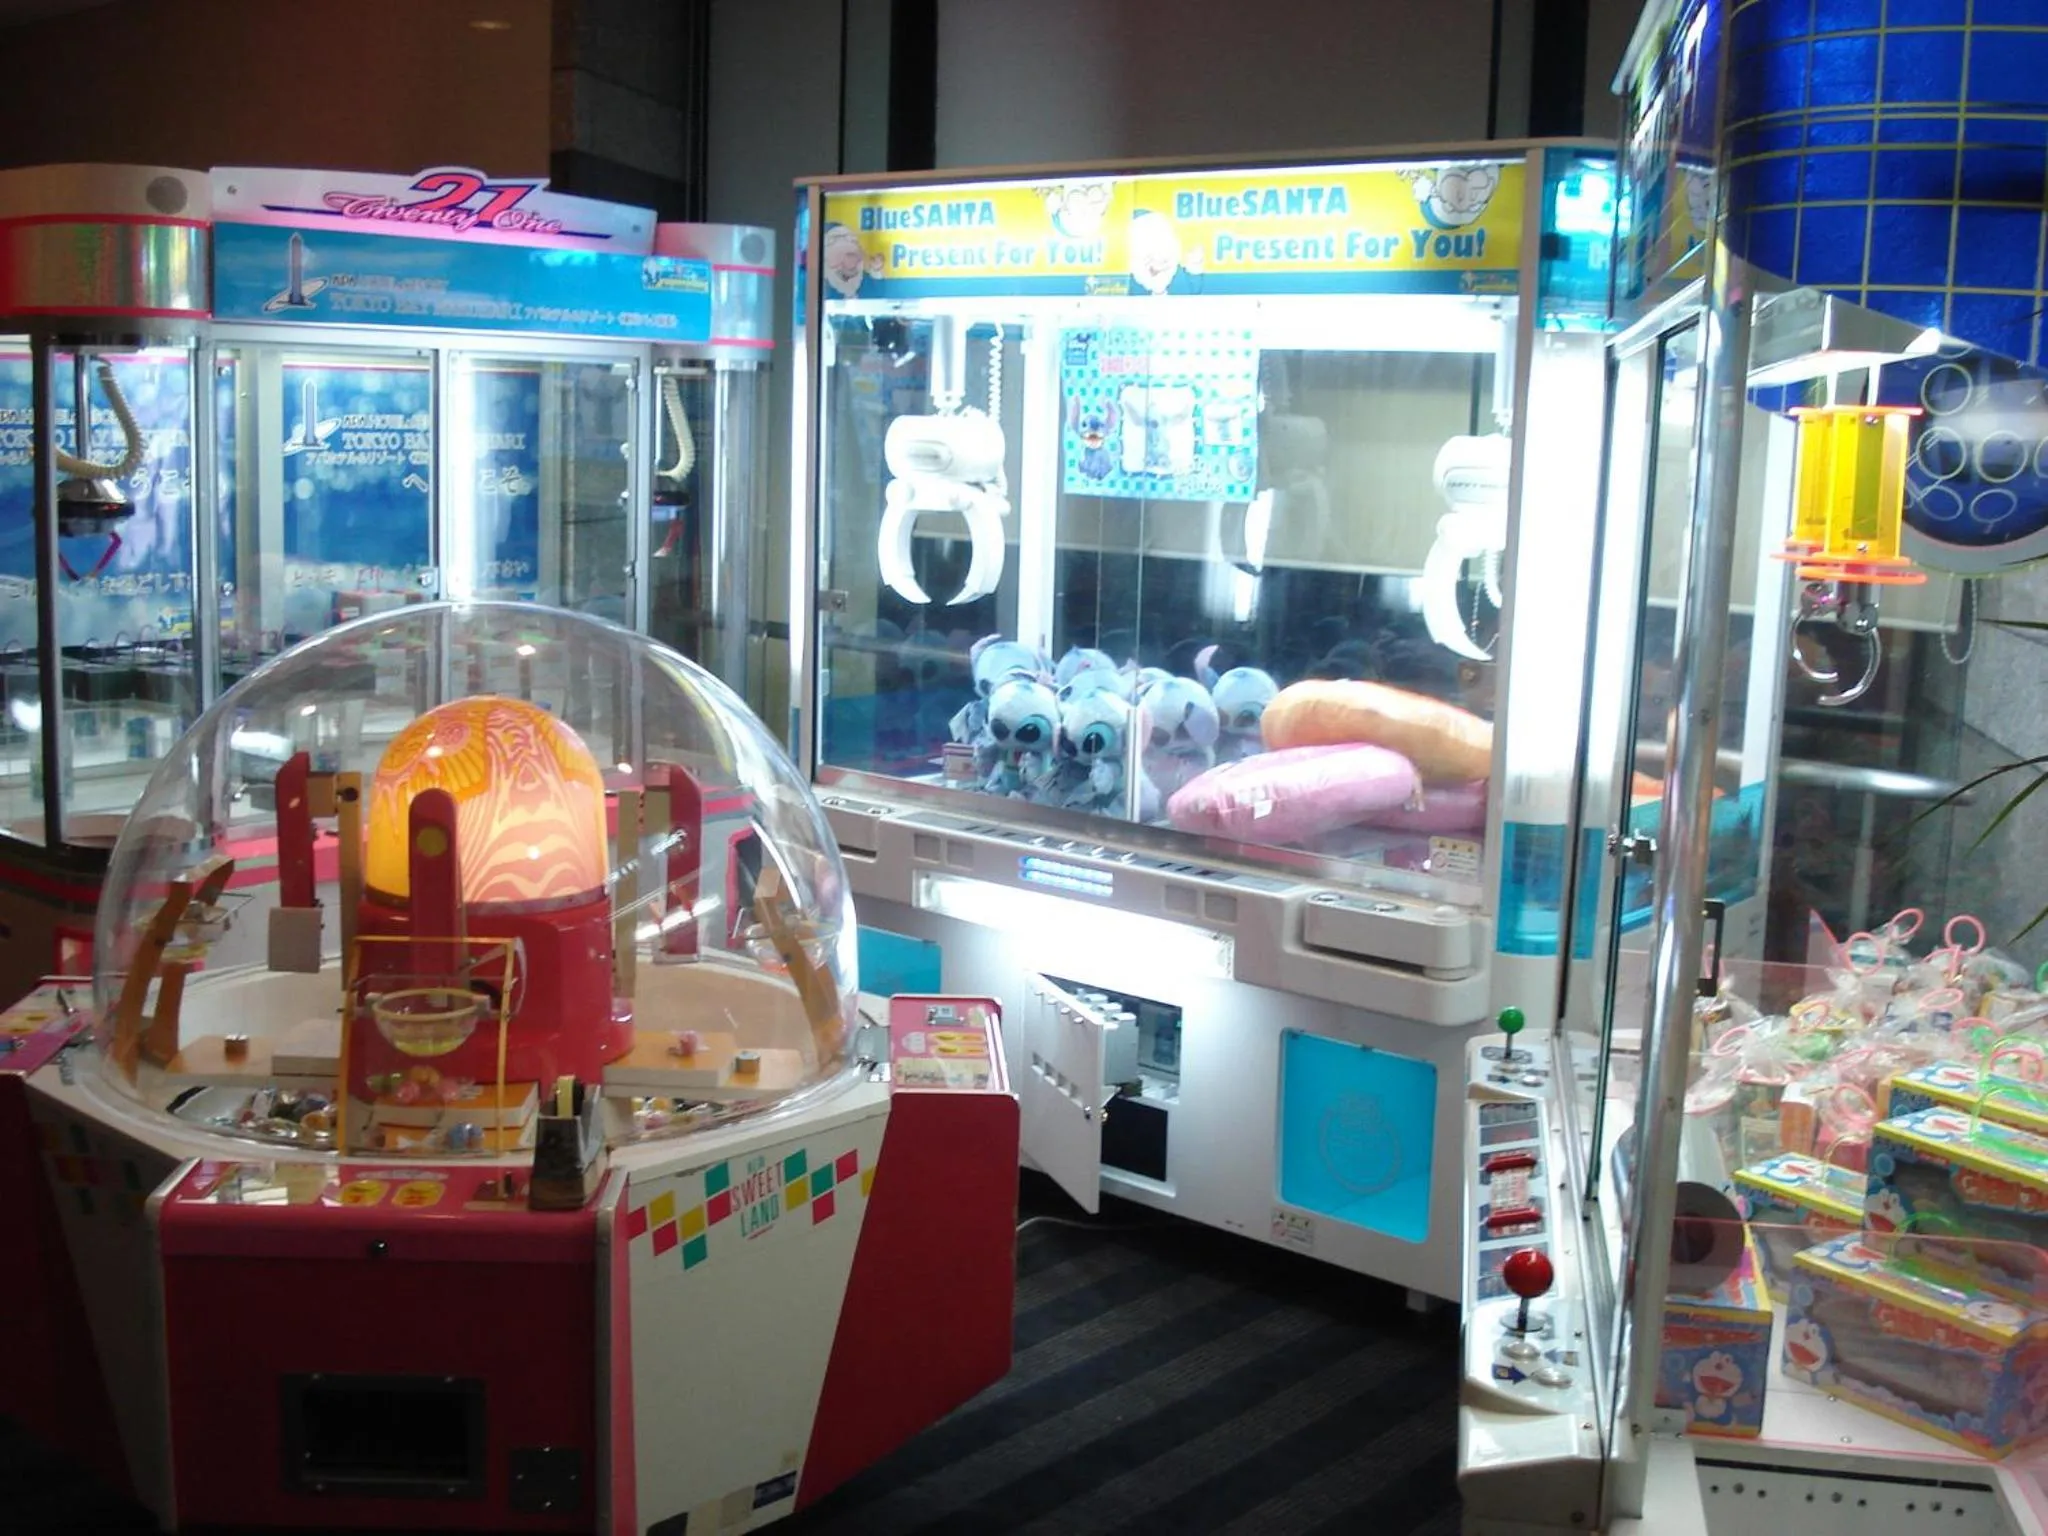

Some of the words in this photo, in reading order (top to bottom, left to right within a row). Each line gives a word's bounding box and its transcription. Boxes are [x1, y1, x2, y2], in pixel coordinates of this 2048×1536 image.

[322, 191, 479, 232] Twenty
[491, 208, 562, 234] One
[410, 172, 538, 227] 21
[859, 201, 995, 231] BlueSANTA
[1175, 186, 1348, 218] BlueSANTA
[892, 243, 987, 268] Present
[995, 243, 1036, 265] For
[1049, 241, 1103, 265] You!
[1215, 233, 1336, 261] Present
[1347, 231, 1399, 258] For
[1410, 228, 1486, 259] You!
[342, 432, 401, 450] TOKYO
[731, 1161, 782, 1213] SWEET
[740, 1194, 780, 1238] LAND
